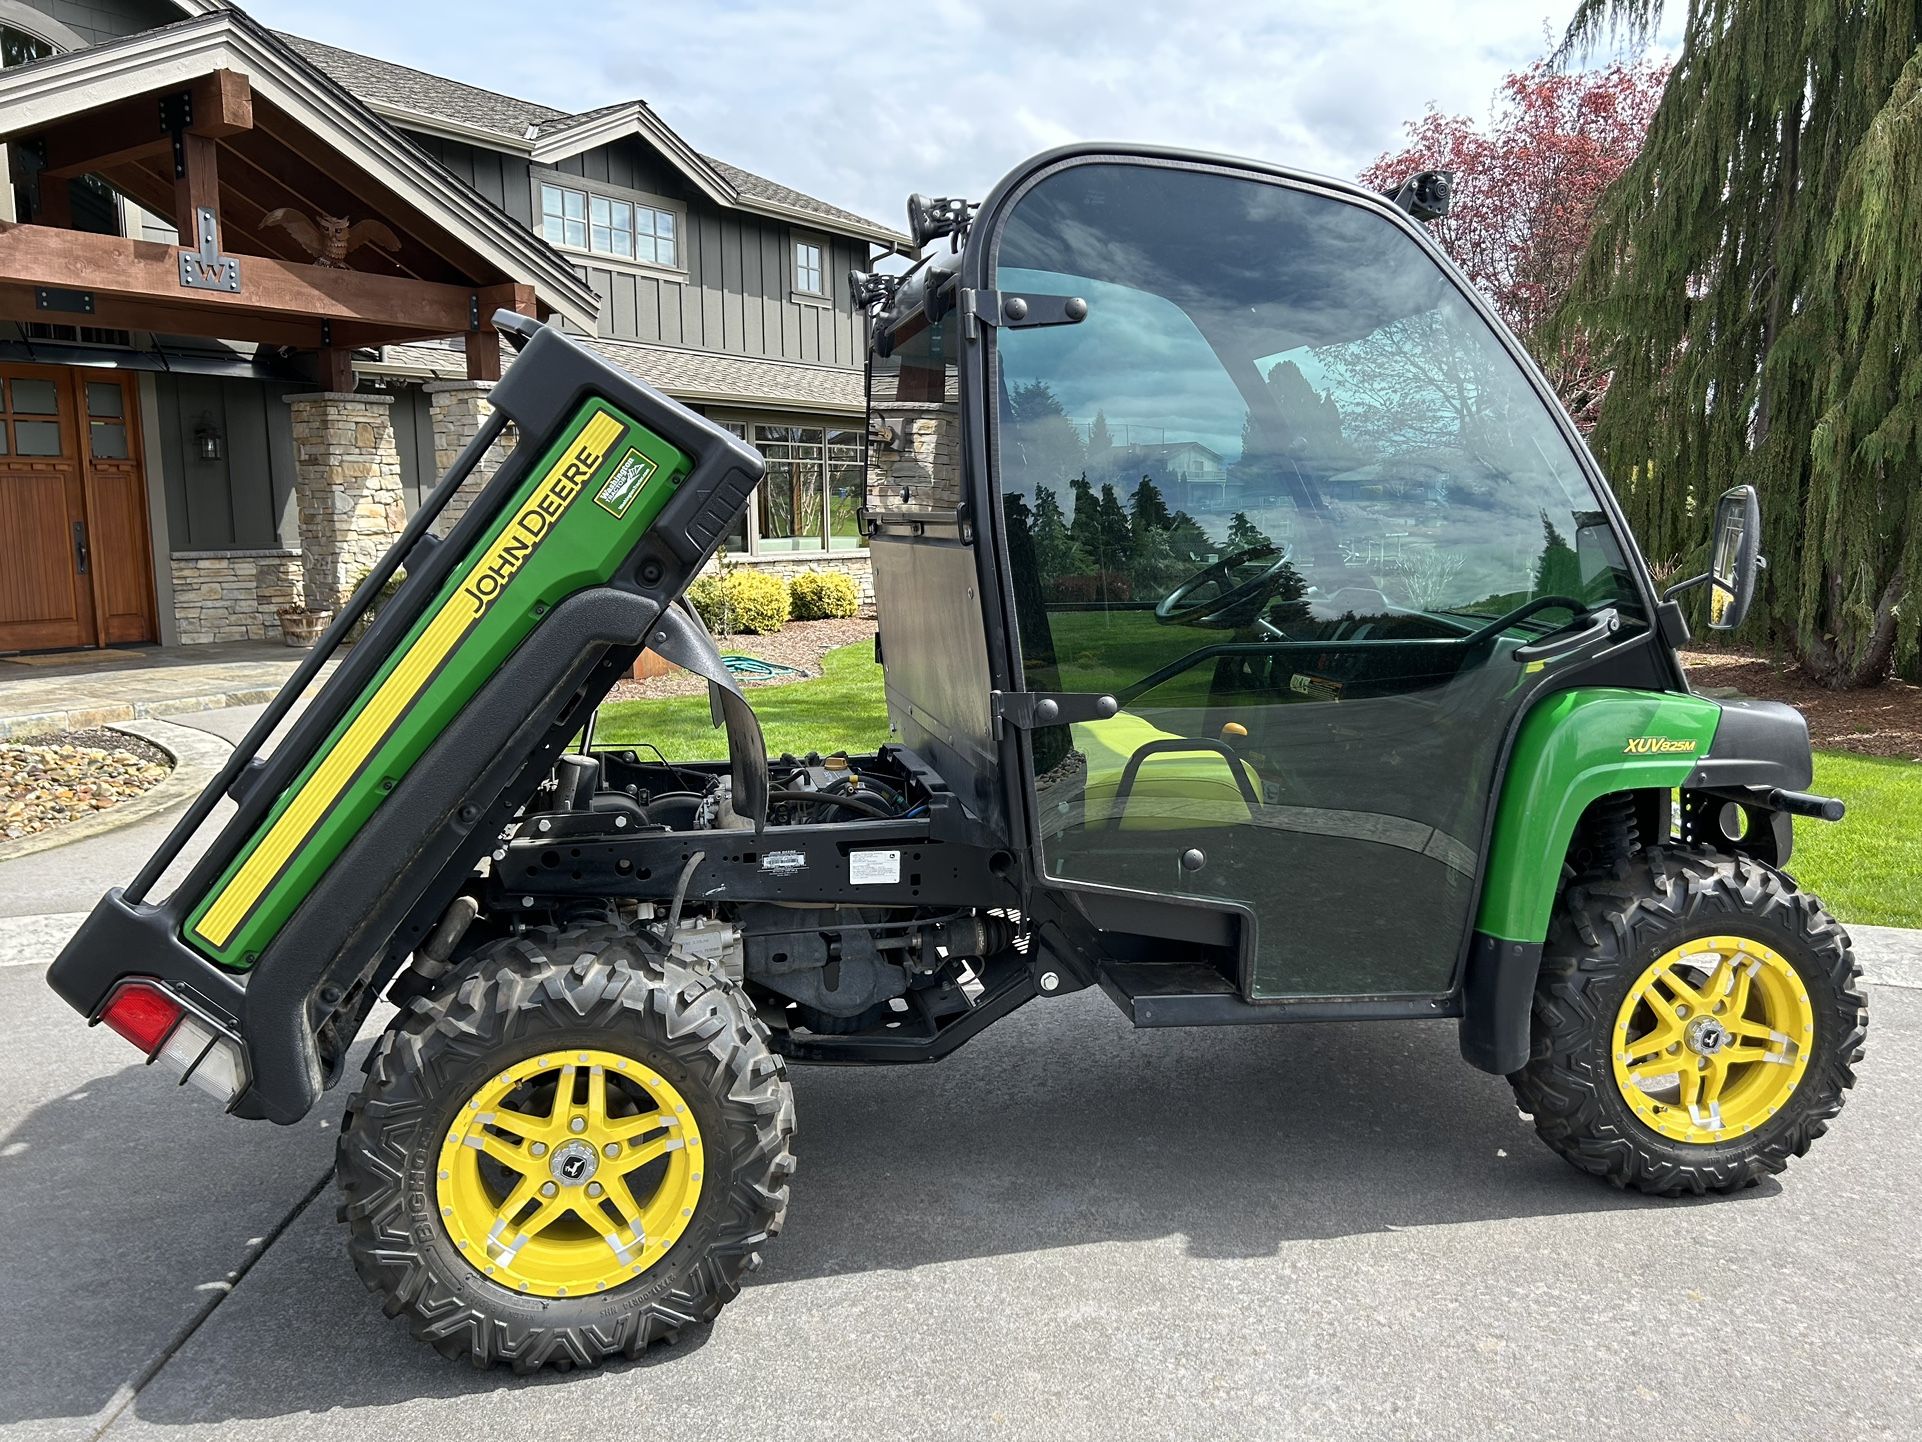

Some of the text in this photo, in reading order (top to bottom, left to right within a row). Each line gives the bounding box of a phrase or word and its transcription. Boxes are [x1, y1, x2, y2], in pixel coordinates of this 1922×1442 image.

[194, 261, 226, 284] W
[600, 457, 635, 499] Washington
[605, 476, 627, 503] TRACTOR
[464, 445, 600, 614] JOHN DEERE
[1623, 738, 1696, 753] XUV825M
[408, 1104, 449, 1243] BIGHORN
